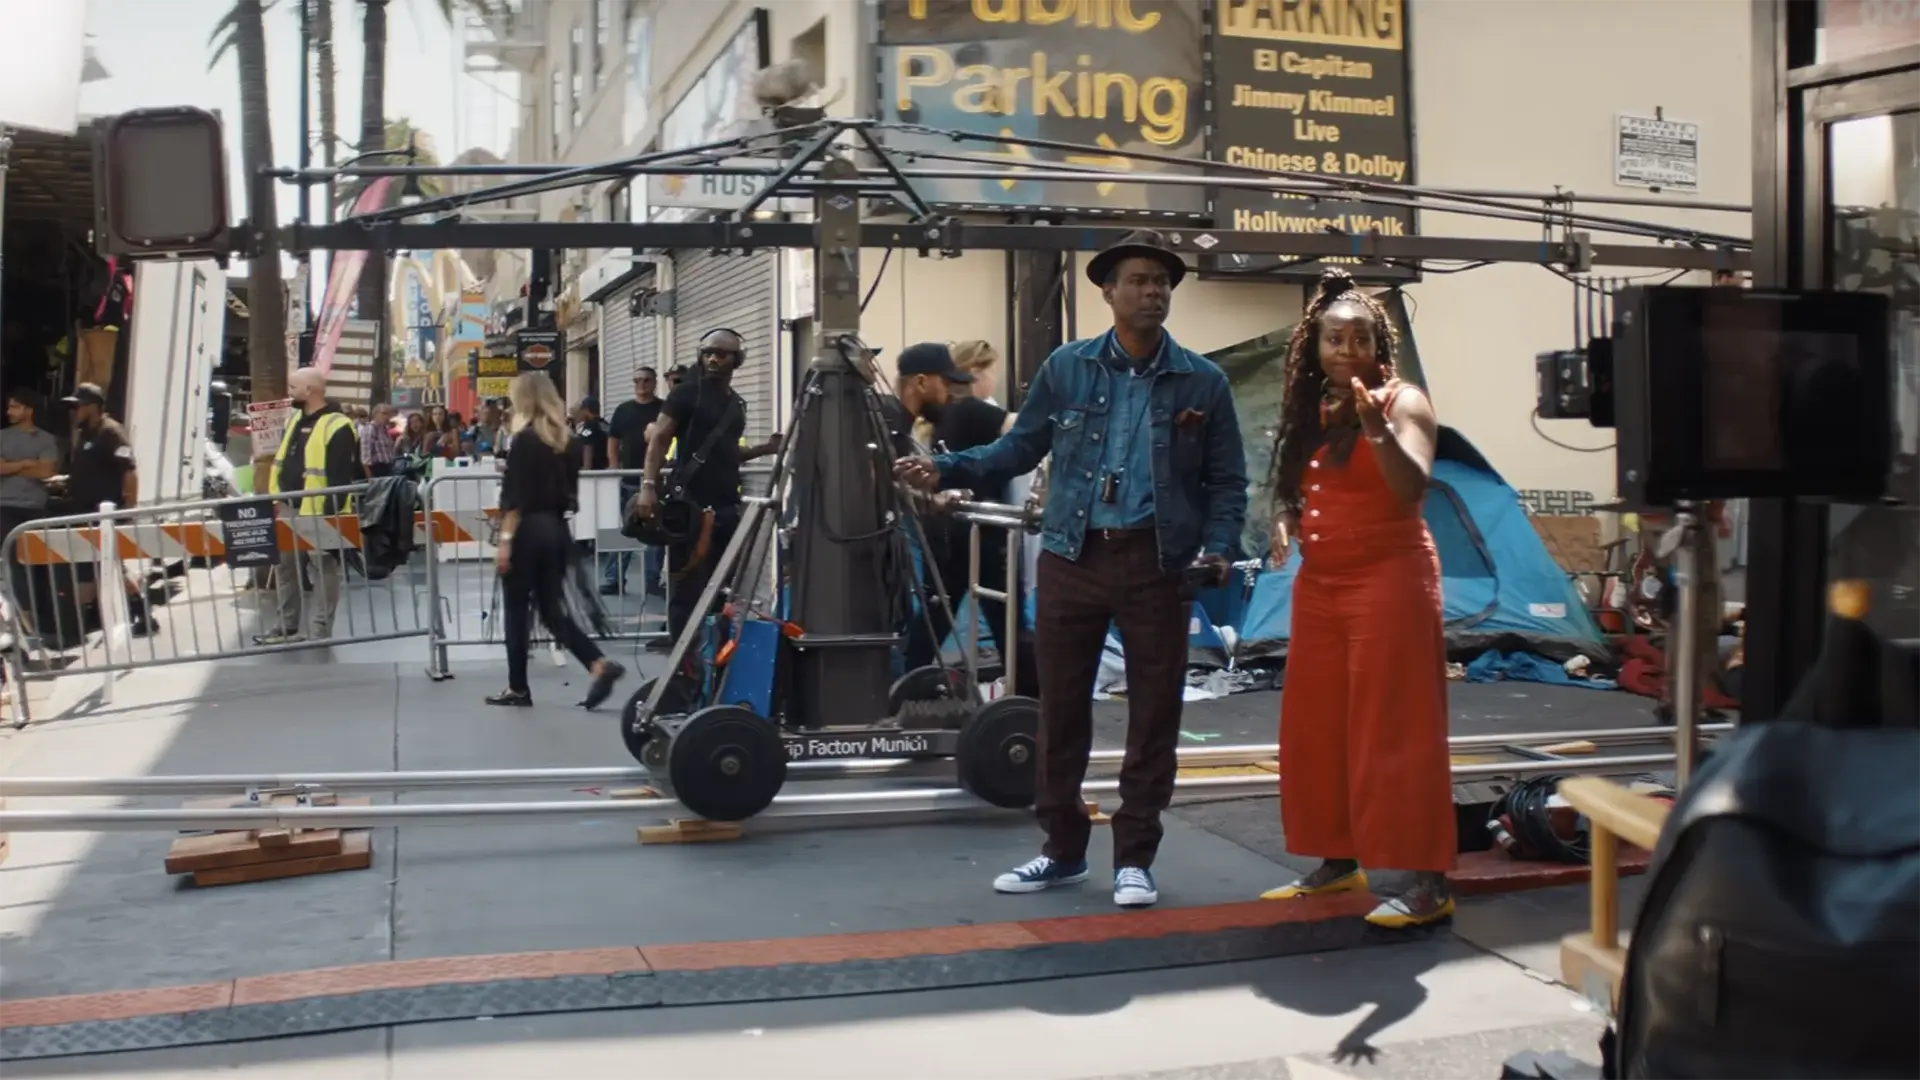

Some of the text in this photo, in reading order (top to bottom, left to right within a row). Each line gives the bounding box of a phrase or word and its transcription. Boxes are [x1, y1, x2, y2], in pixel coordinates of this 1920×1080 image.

[1253, 49, 1373, 80] El Capitan
[896, 46, 1189, 145] Parking
[1232, 84, 1395, 116] Jimmy Kimmel
[1294, 118, 1340, 142] Live
[1226, 146, 1406, 182] Chinese & Dolby
[237, 507, 257, 519] NO
[808, 737, 868, 756] Factory
[871, 735, 928, 753] Munich
